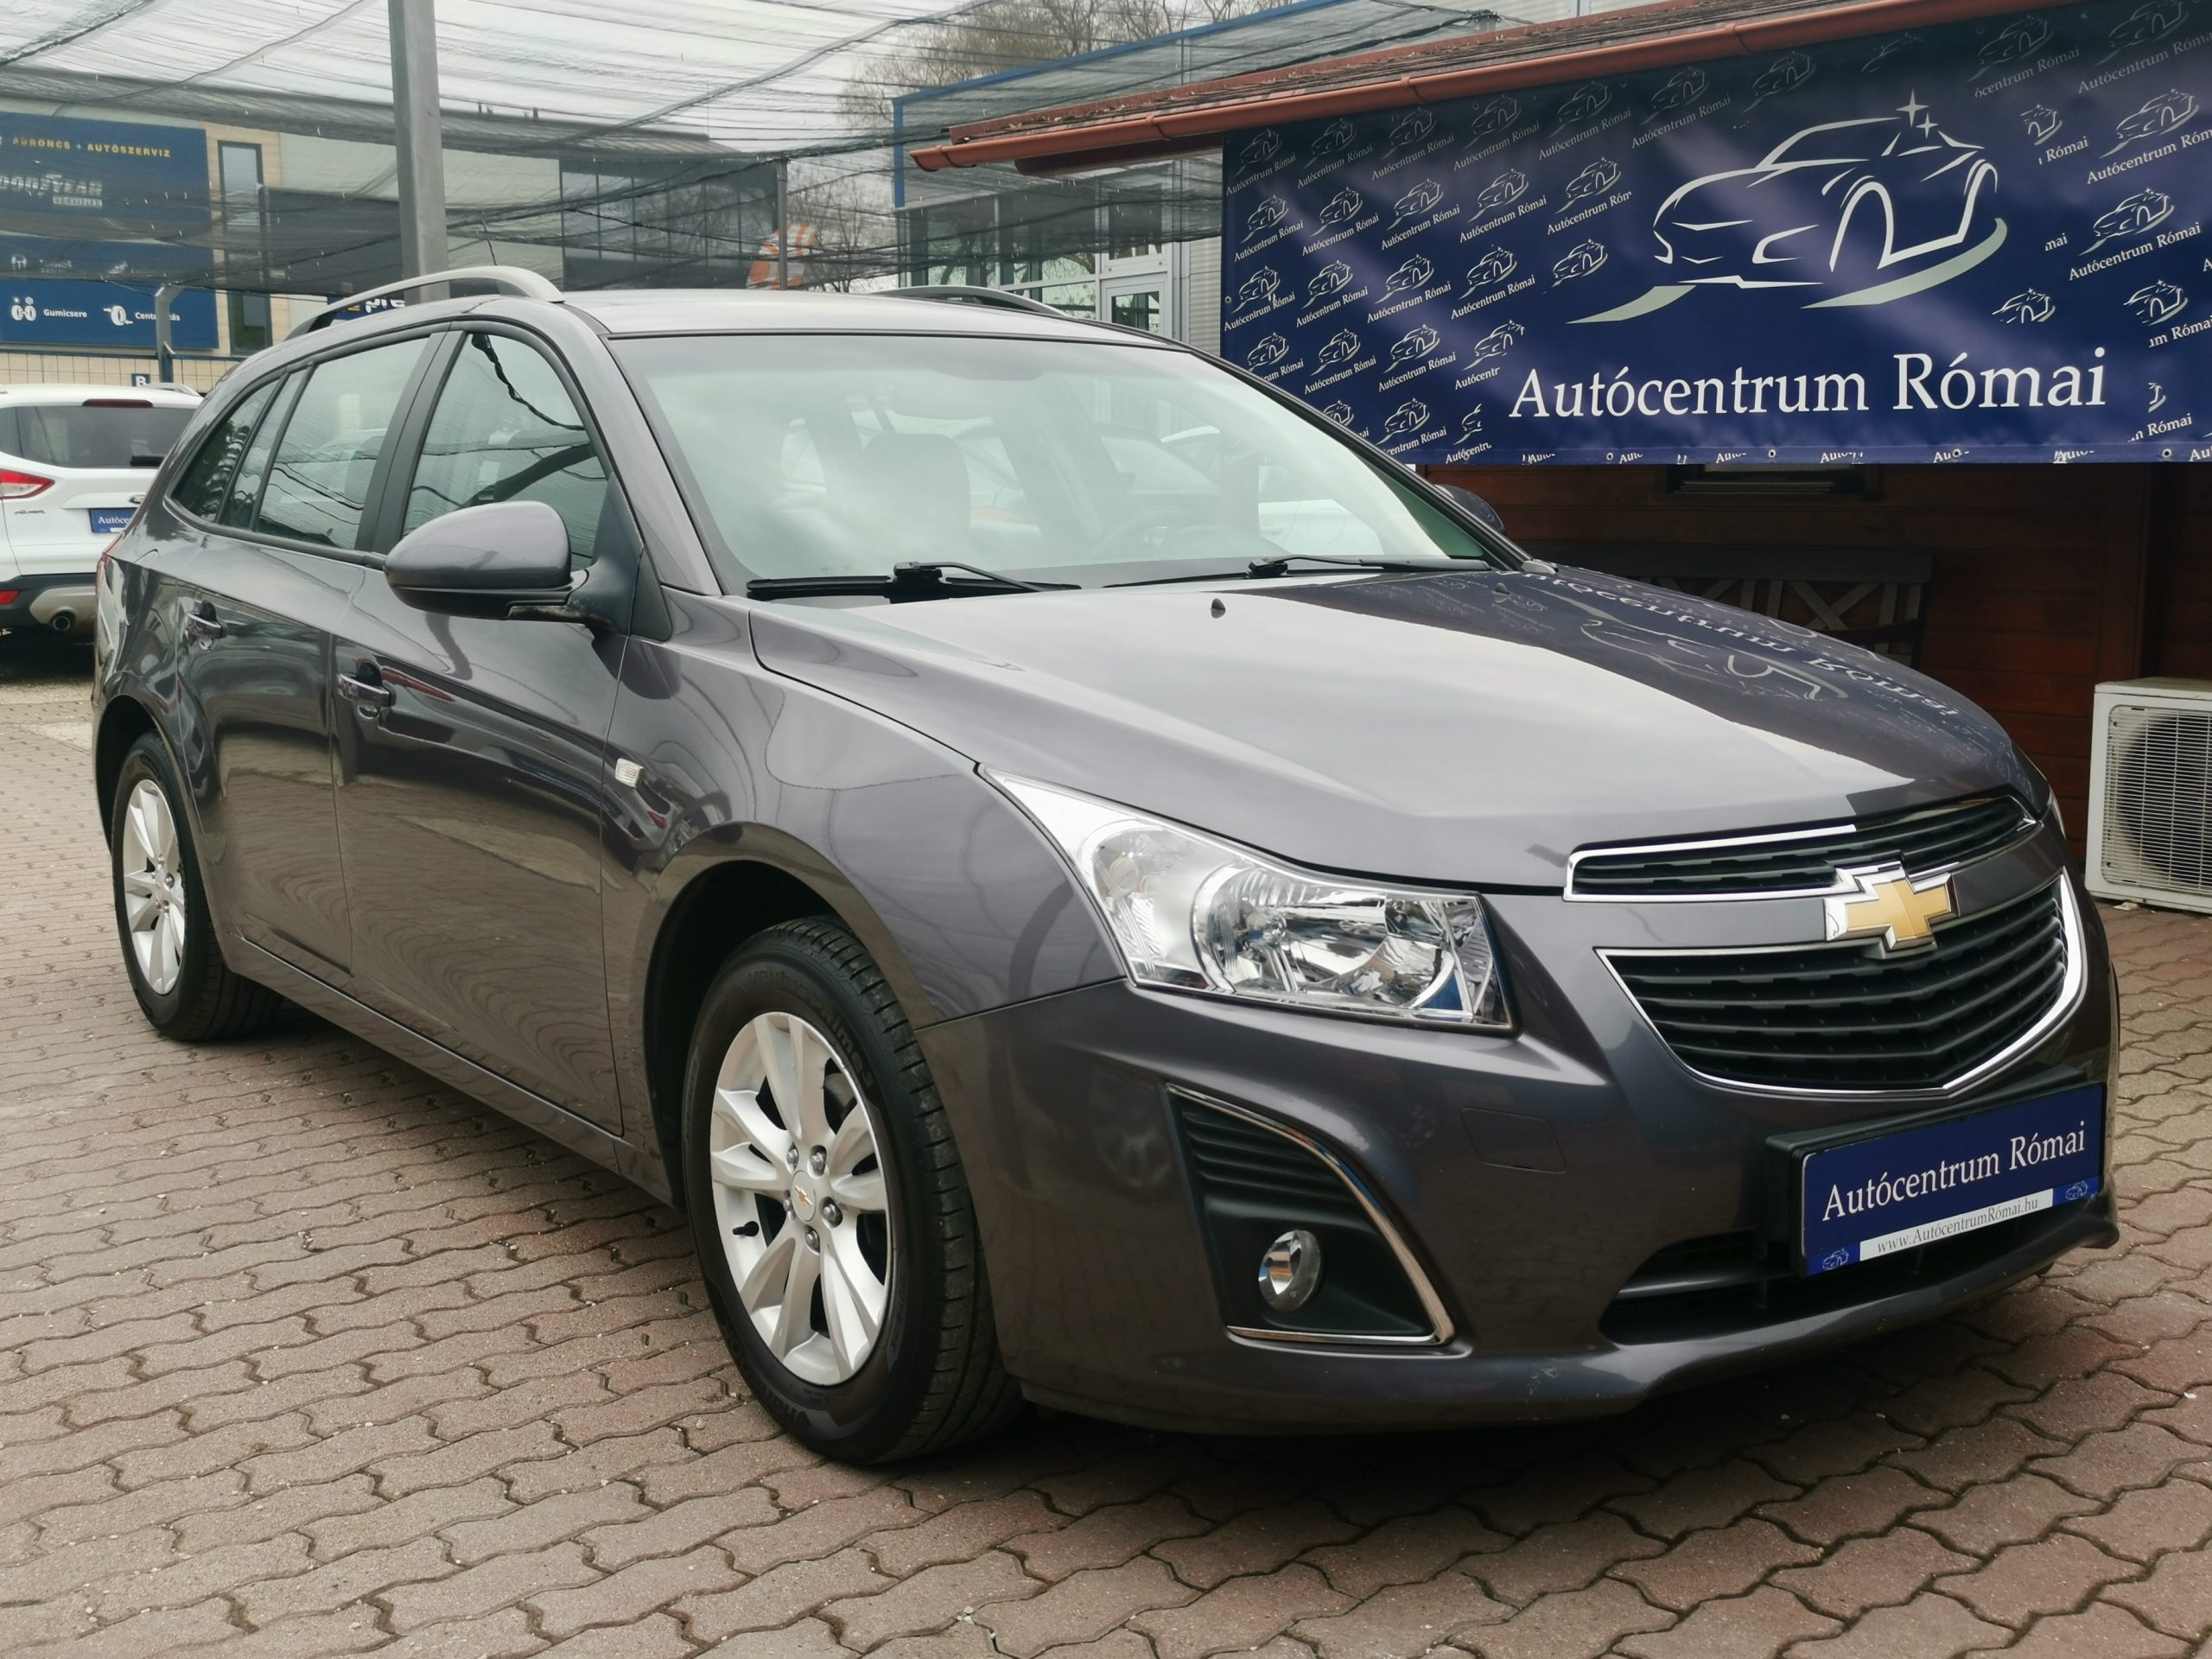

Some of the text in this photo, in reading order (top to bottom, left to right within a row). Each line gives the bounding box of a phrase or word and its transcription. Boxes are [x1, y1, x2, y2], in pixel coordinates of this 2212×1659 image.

[2037, 46, 2080, 73] Római
[2078, 52, 2169, 93] Autócentrum
[1539, 110, 1631, 160] Autócentrum Római
[1631, 94, 1731, 149] Autócentrum Római
[87, 142, 171, 157] AUTÓSZERVIZ
[1372, 134, 1455, 181] Autócentrum Római
[1453, 121, 1540, 171] Autócentrum Római
[2046, 136, 2088, 162] Római
[2087, 143, 2177, 184] Autócentrum
[1226, 154, 1296, 196] Autócentrum Római
[1298, 145, 1373, 189] Autócentrum Római
[1302, 213, 1379, 256] Autócentrum Római
[1382, 205, 1460, 251] Autócentrum Római
[1460, 195, 1547, 243] Autócentrum Római
[1548, 205, 1607, 235] Autócentrum
[1235, 221, 1304, 263] Autócentrum Római
[2069, 222, 2201, 281] Autócentrum Római
[44, 308, 87, 318] Gumicsere
[1224, 291, 1295, 332] Autócentrum Római
[1296, 286, 1368, 327] Autócentrum Római
[1367, 282, 1452, 323] Autócentrum Római
[1451, 275, 1535, 320] Autócentrum Római
[1281, 358, 1304, 374] Római
[1305, 367, 1353, 394] Autócentrum
[1354, 355, 1376, 372] Római
[1379, 352, 1456, 392] Autócentrum Római
[1509, 346, 2107, 417] Autócentrum Római
[1421, 426, 1446, 443] Római
[2147, 413, 2192, 436] Római
[1822, 1121, 2086, 1221] Autócentrum Római
[1878, 1197, 2038, 1253] www.AutócentrumRómai.hu
